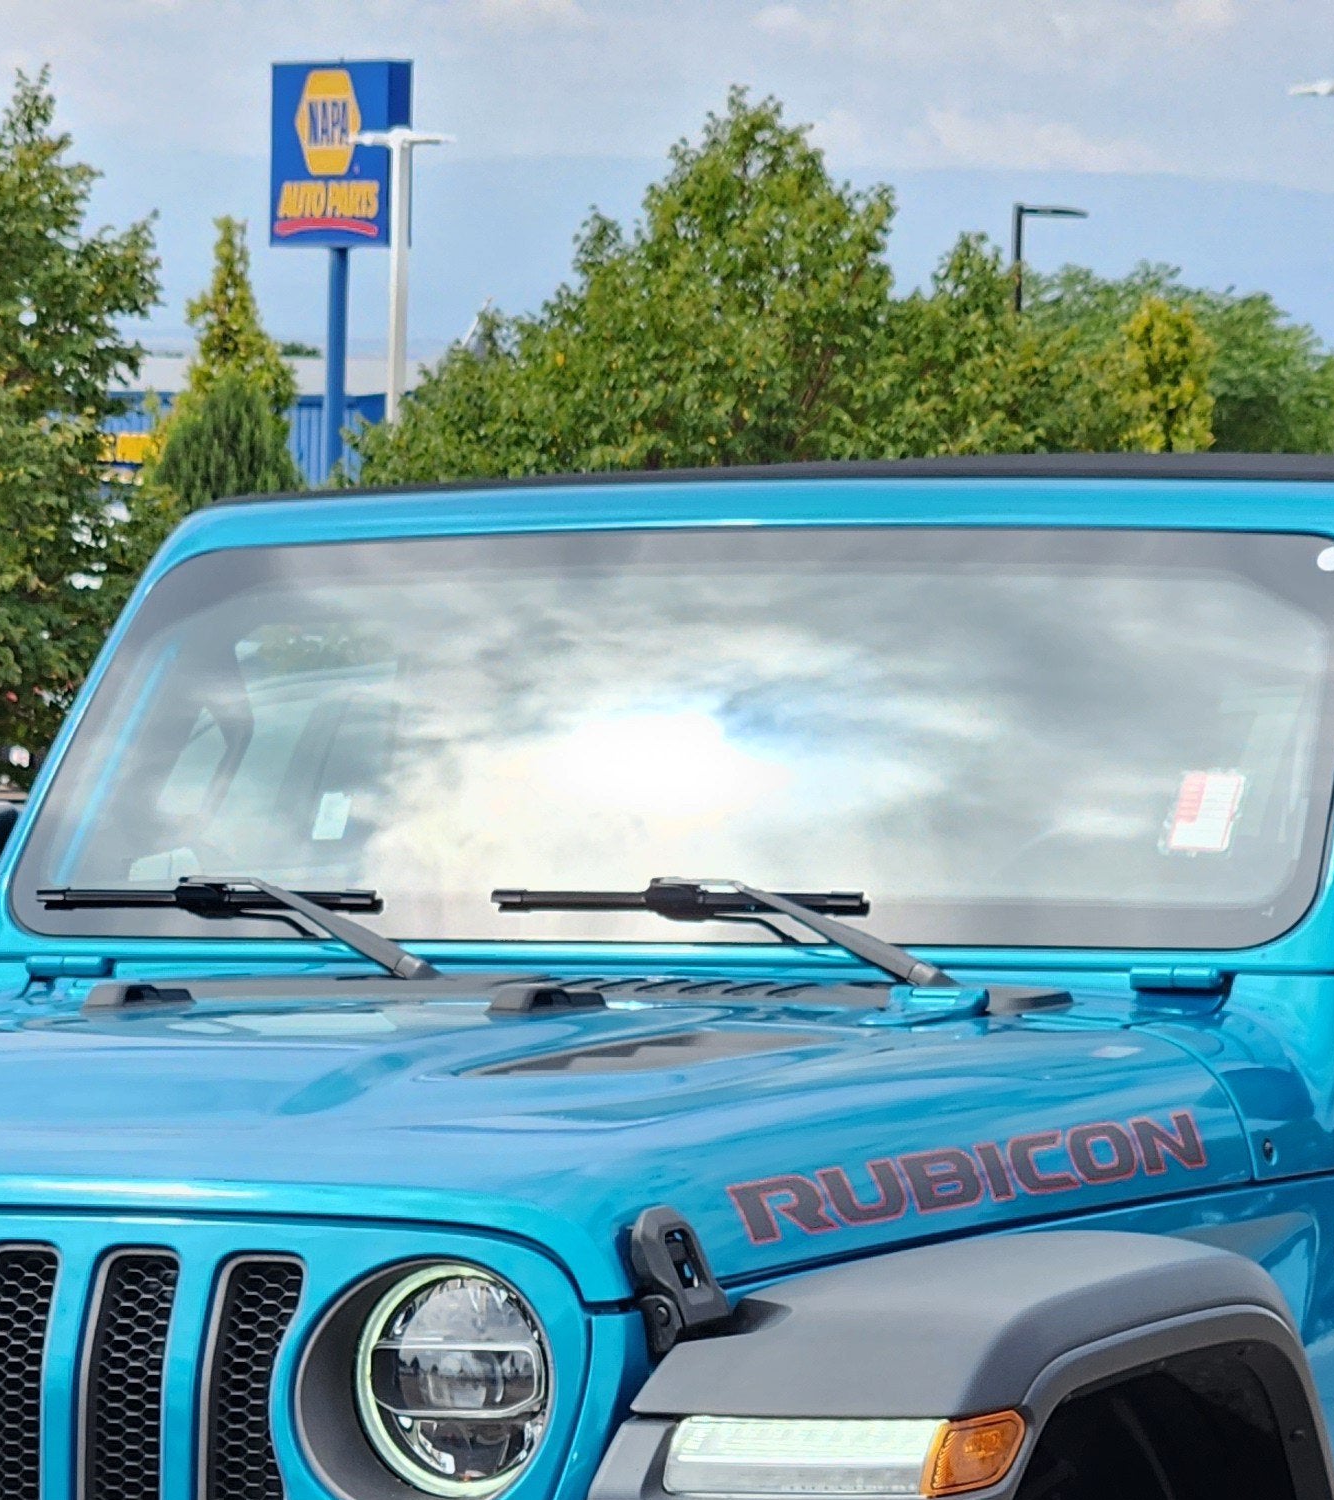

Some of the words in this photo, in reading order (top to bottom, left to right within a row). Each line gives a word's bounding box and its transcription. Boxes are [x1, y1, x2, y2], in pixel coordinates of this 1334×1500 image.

[308, 101, 351, 146] NAPA
[277, 181, 327, 217] AUTO
[326, 180, 380, 218] PARTS
[727, 1110, 1209, 1245] RUBICON
